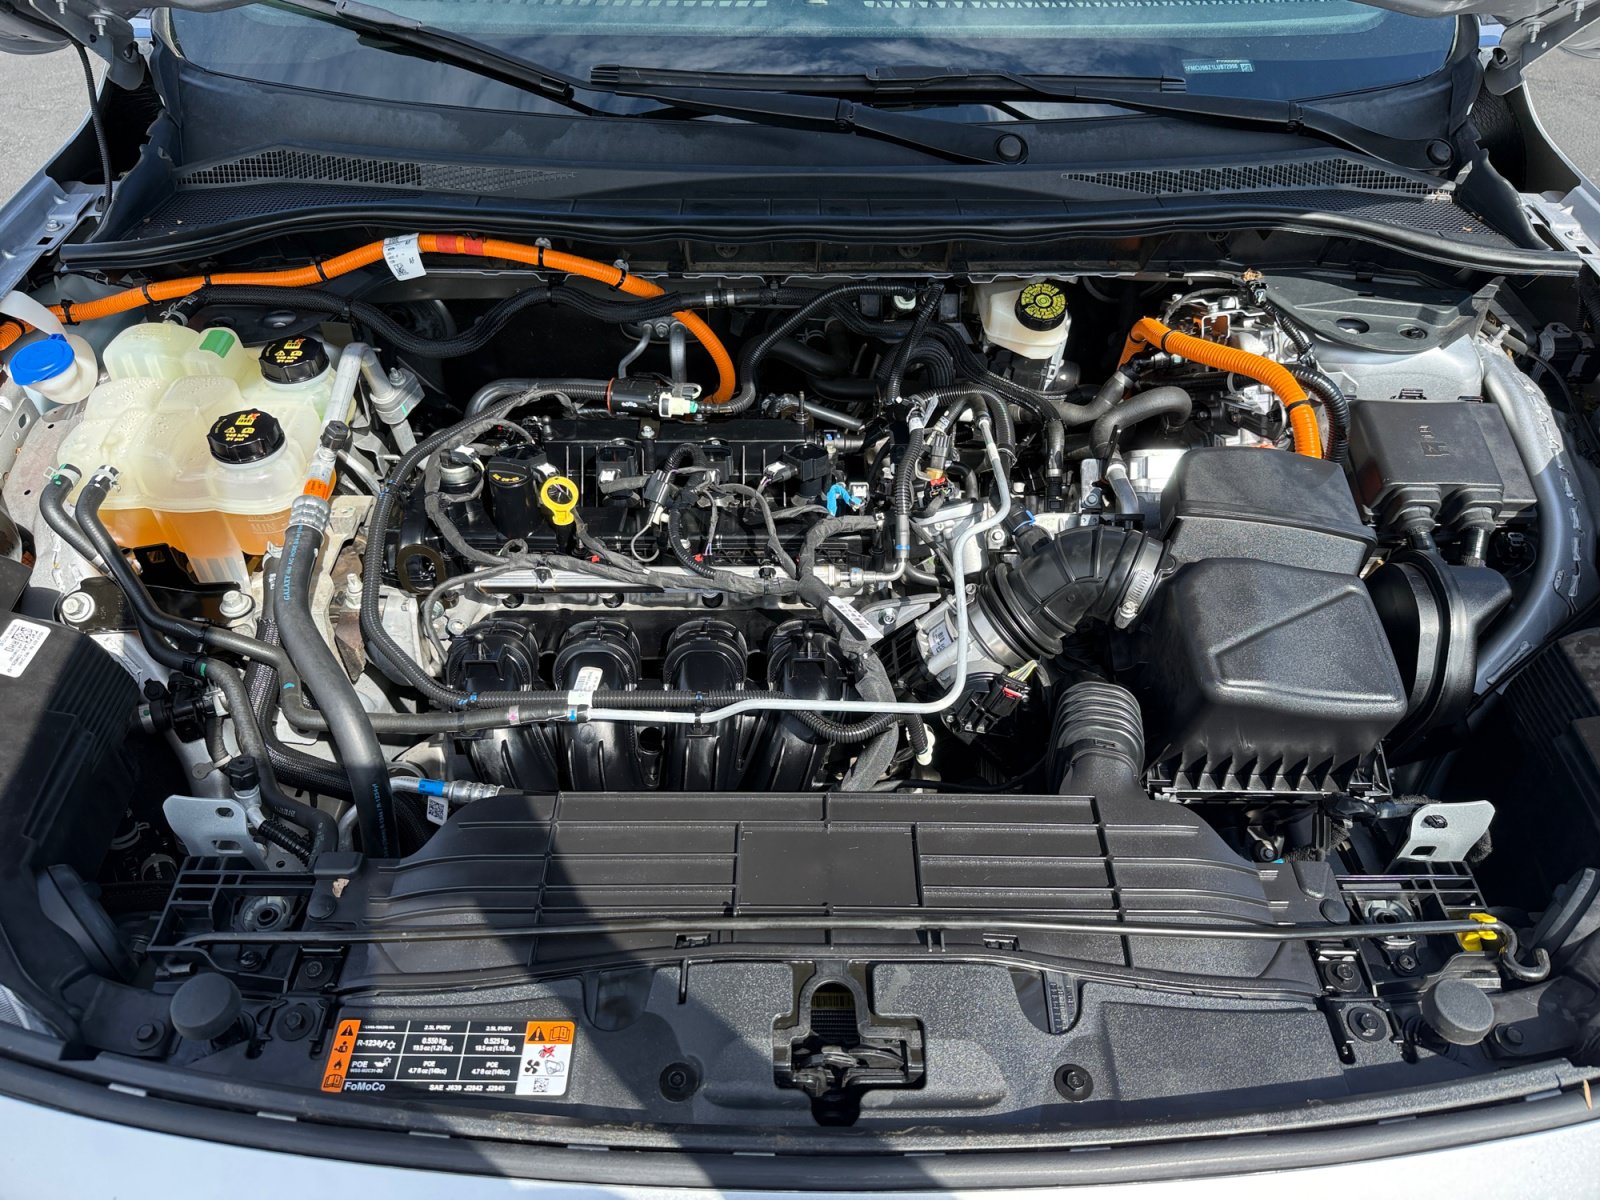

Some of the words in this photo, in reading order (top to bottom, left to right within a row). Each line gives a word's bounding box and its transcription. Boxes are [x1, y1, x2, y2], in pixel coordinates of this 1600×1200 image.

[283, 575, 291, 601] GALAXY
[356, 1039, 388, 1048] R-1234yf
[422, 1037, 439, 1045] 0.550
[439, 1037, 447, 1046] kg
[484, 1037, 501, 1045] 0.525
[501, 1037, 509, 1046] kg
[344, 1082, 385, 1091] FoMoCo
